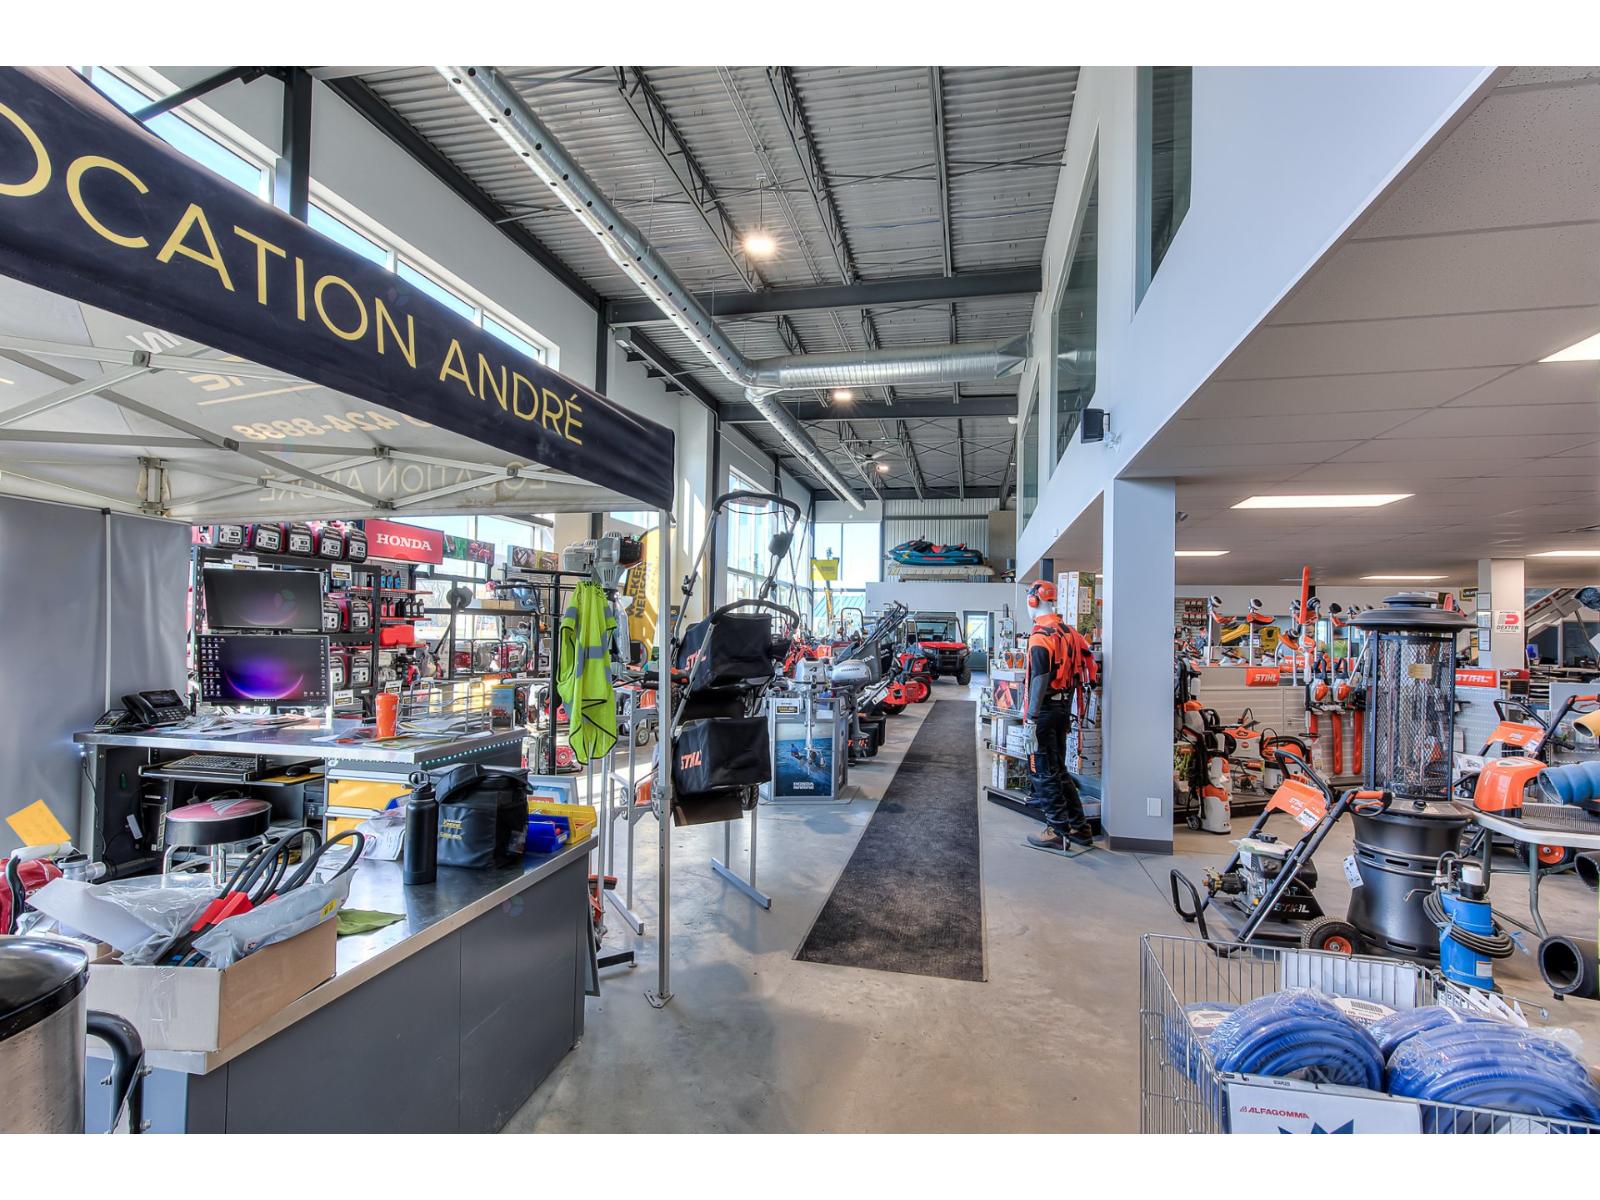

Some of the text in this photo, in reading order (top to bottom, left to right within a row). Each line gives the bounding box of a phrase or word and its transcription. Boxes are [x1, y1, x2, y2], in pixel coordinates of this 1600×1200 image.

[438, 338, 583, 446] ANDRÉ
[376, 533, 432, 551] HONDA
[1254, 674, 1278, 682] STIHL
[1456, 674, 1490, 683] STIHL
[1248, 1106, 1310, 1119] ALFAGOMMA
